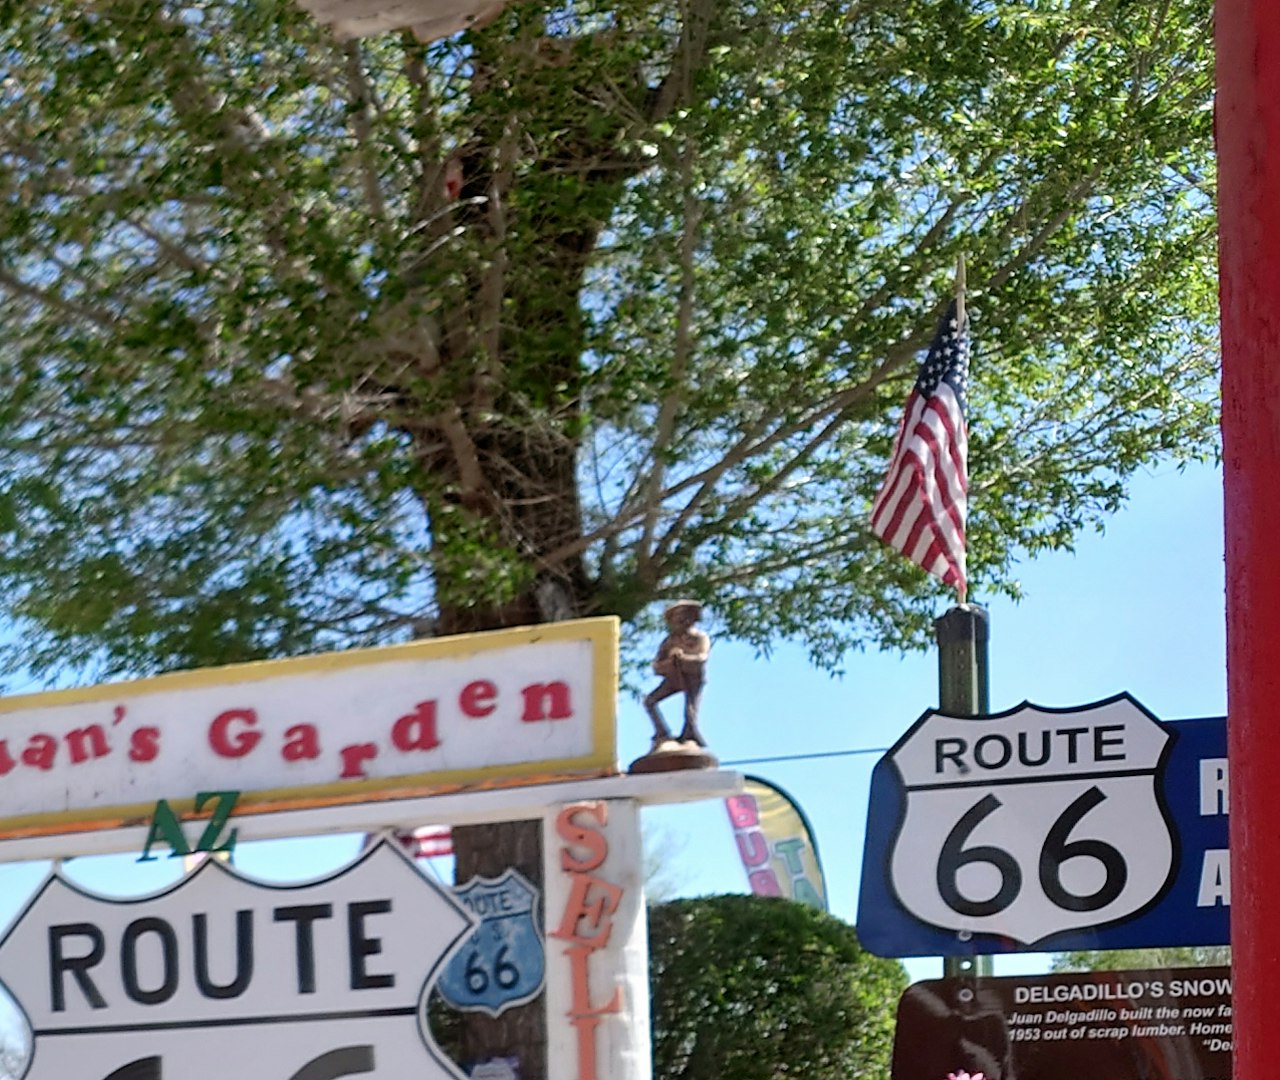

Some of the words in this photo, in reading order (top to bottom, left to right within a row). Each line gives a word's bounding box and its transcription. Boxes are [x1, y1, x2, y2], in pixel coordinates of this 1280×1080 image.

[208, 678, 573, 779] Garden
[935, 724, 1127, 775] ROUTE
[137, 791, 241, 862] AZ
[936, 784, 1129, 917] 66
[49, 899, 396, 1012] ROUTE
[465, 944, 520, 995] 66
[1008, 1012, 1042, 1026] Juan
[1045, 1008, 1117, 1025] Delgadillo
[1119, 1007, 1153, 1021] built
[1156, 1006, 1180, 1019] the
[1182, 1007, 1215, 1018] now
[1015, 981, 1164, 1004] DELGADILLO'S
[1008, 1028, 1041, 1042] 1953
[1043, 1028, 1067, 1040] out
[1070, 1026, 1087, 1039] of
[1088, 1027, 1129, 1041] scrap
[1132, 1024, 1186, 1037] lumber.
